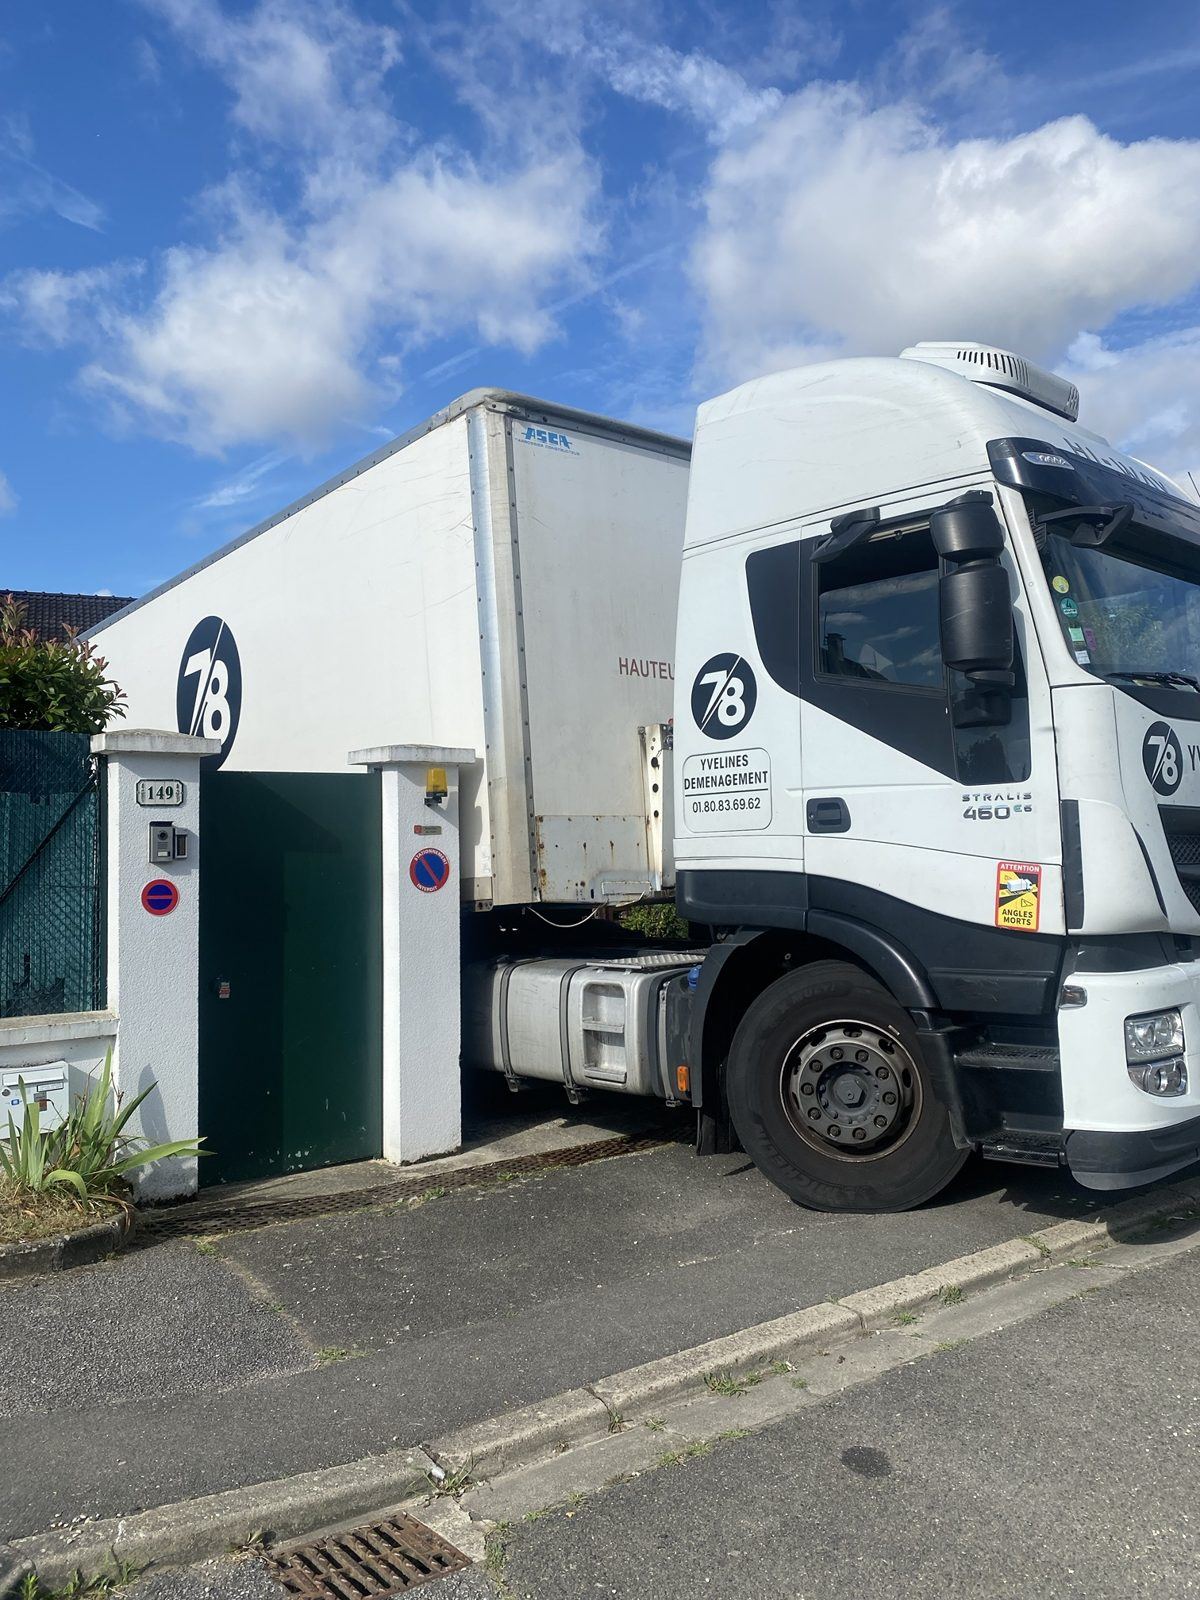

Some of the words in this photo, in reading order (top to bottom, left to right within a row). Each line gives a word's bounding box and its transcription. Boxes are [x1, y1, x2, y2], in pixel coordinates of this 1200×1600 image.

[183, 647, 231, 746] 78
[699, 669, 746, 727] 78
[700, 754, 749, 771] YVELINES
[1147, 735, 1179, 786] 78
[684, 770, 768, 790] DEMENAGEMENT
[147, 785, 174, 800] 149
[961, 792, 1032, 802] STRALIS
[692, 797, 761, 813] 01.80.83.69.62
[962, 804, 1011, 820] 460
[415, 849, 448, 865] STATIONNEMENT
[1000, 863, 1040, 872] ATTENTION
[417, 883, 438, 892] INTERDIT
[1002, 909, 1033, 918] ANGLES
[1003, 916, 1031, 925] MORTS
